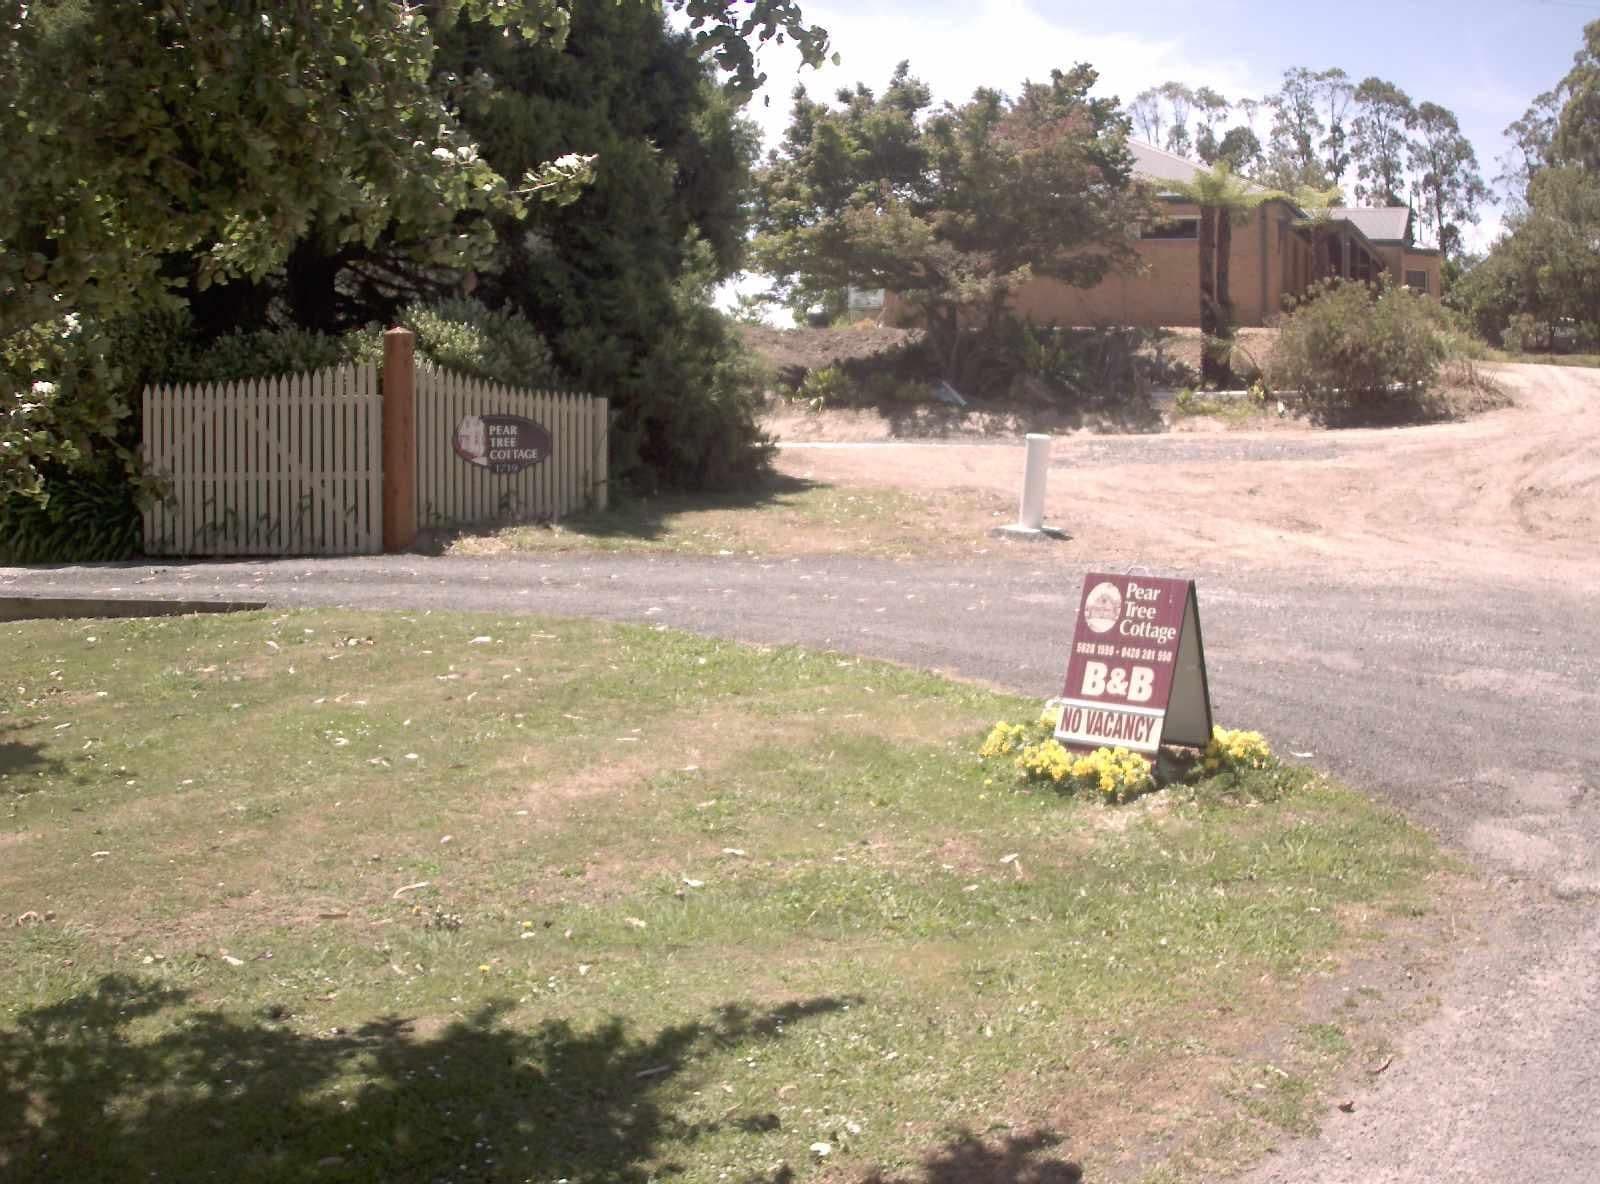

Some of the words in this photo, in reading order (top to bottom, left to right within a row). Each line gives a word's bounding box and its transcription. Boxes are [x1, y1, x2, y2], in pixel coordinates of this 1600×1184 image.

[489, 424, 518, 435] PEAR
[490, 437, 518, 448] TREE
[489, 448, 538, 460] COTTAGE
[1126, 582, 1161, 602] Pear
[1125, 601, 1157, 620] Tree
[1120, 619, 1177, 644] Cottage
[1080, 661, 1155, 702] B&B
[1060, 706, 1083, 734] NO
[1085, 709, 1157, 743] VACANCY
